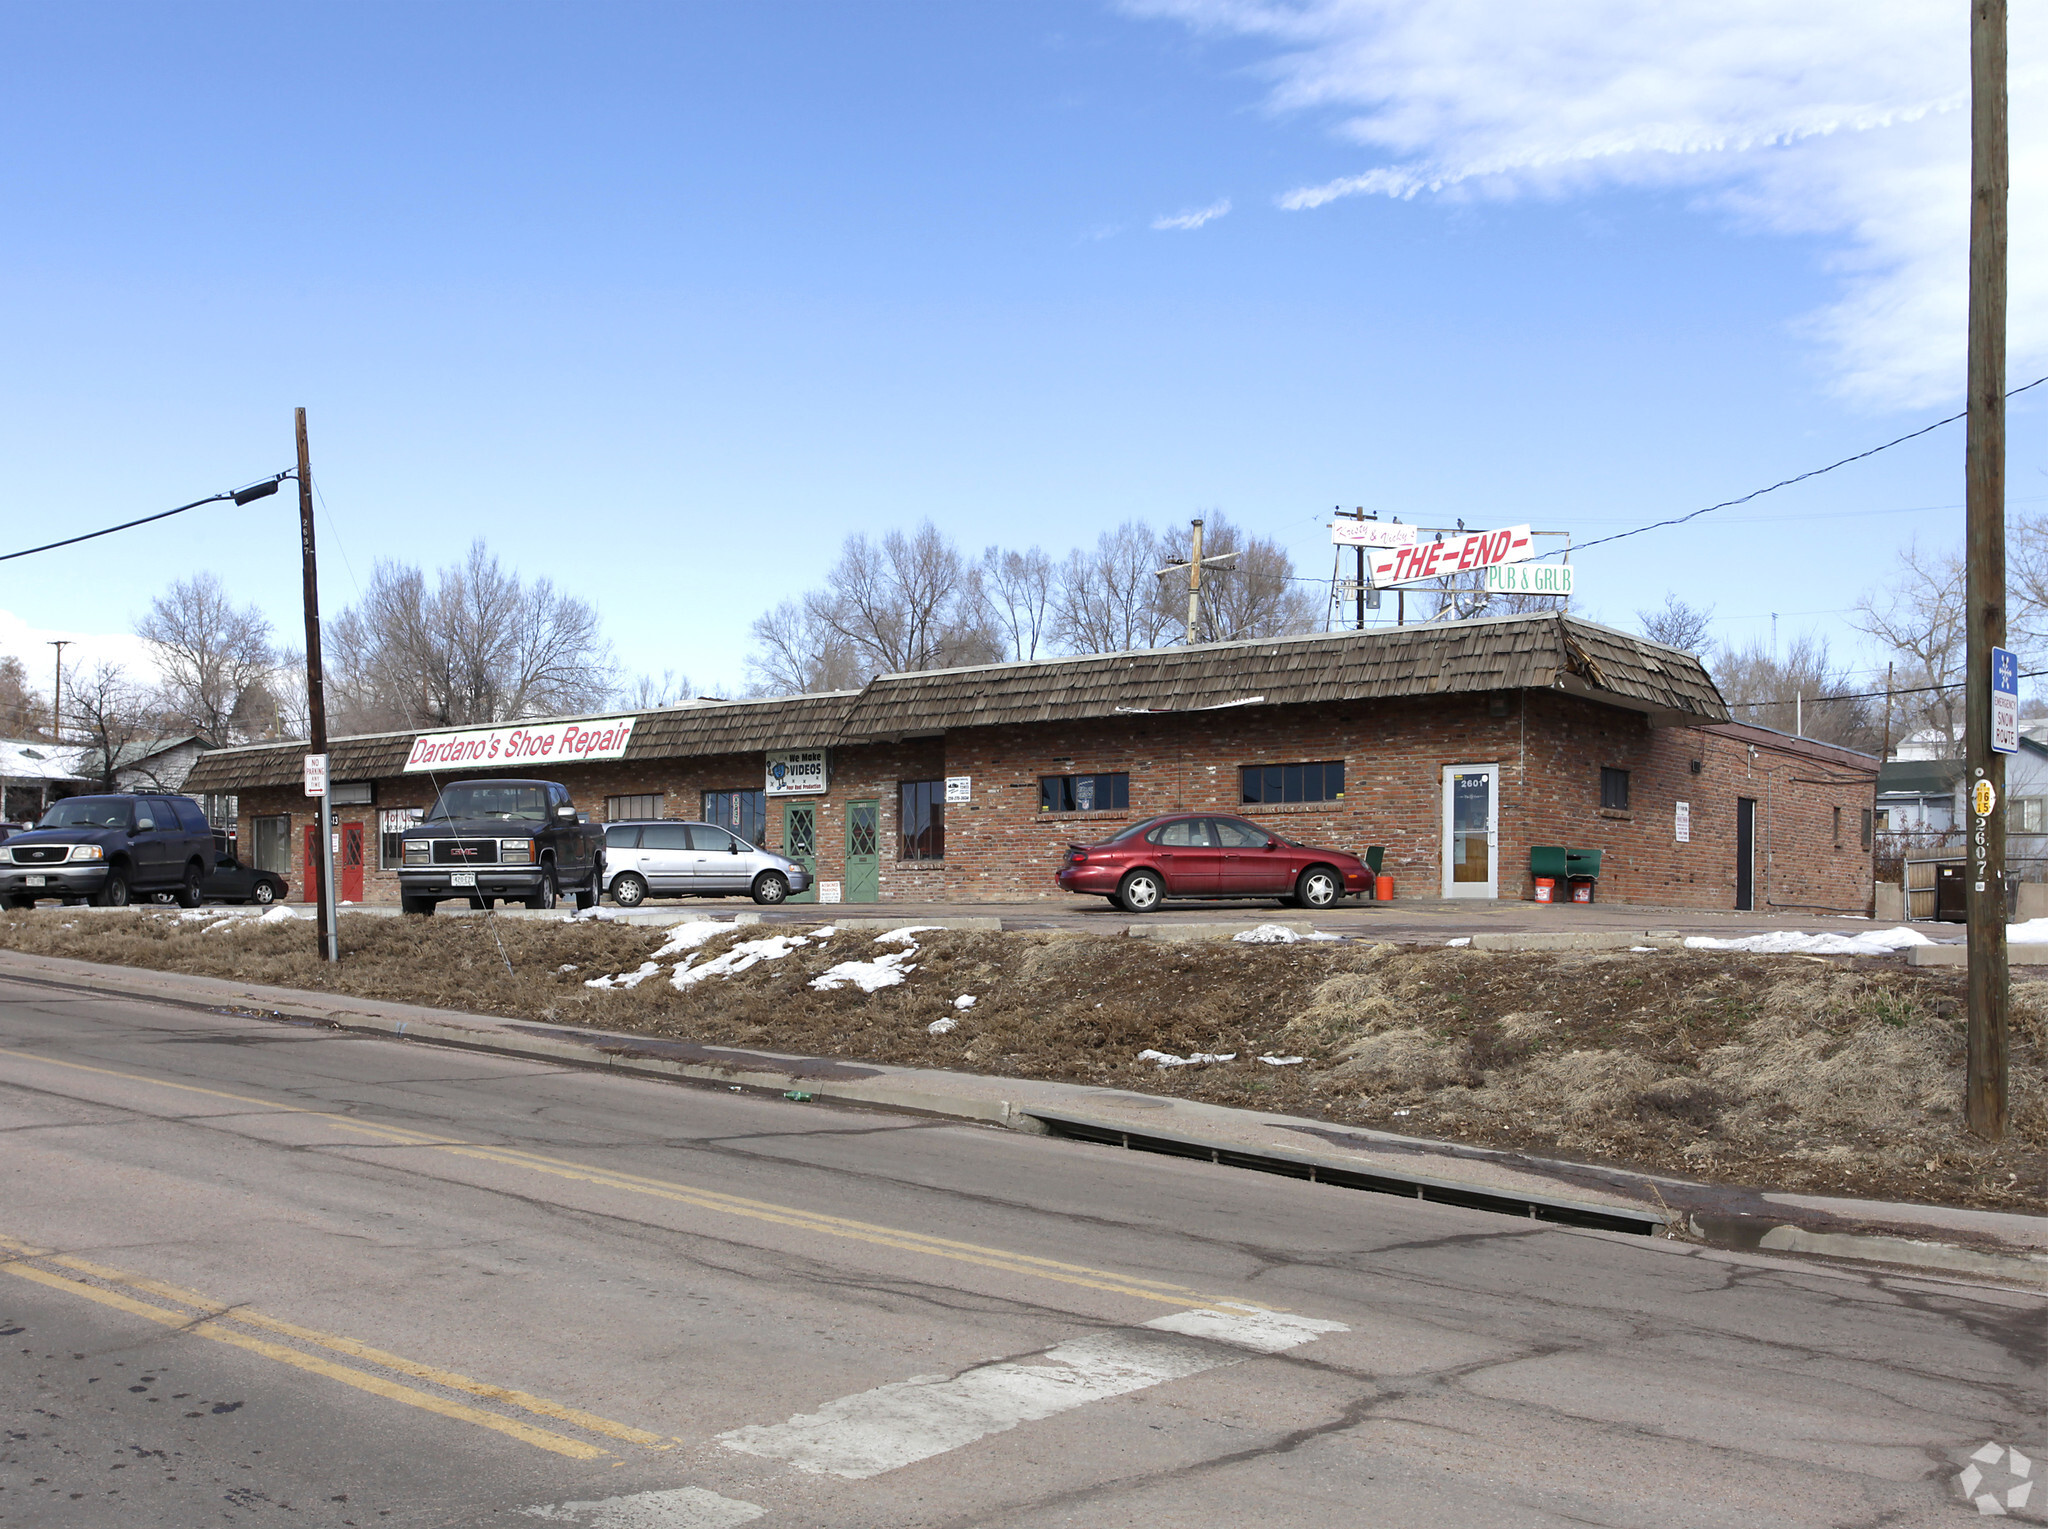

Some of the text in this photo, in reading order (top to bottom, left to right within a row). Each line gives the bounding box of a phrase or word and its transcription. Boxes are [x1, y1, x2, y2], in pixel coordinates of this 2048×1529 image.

[1370, 530, 1377, 541] &
[1489, 565, 1571, 591] PUB & GRUB
[1994, 696, 2016, 710] EMERGENCY
[1998, 711, 2014, 728] SNOW
[409, 721, 631, 765] Dardano's Shoe Repair
[1996, 728, 2015, 746] ROUTE
[312, 758, 319, 767] NO
[789, 752, 821, 763] We Make
[789, 763, 821, 776] VIDEOS
[1461, 779, 1483, 788] 2601
[450, 848, 478, 856] GMC
[1975, 817, 1987, 875] 2607
